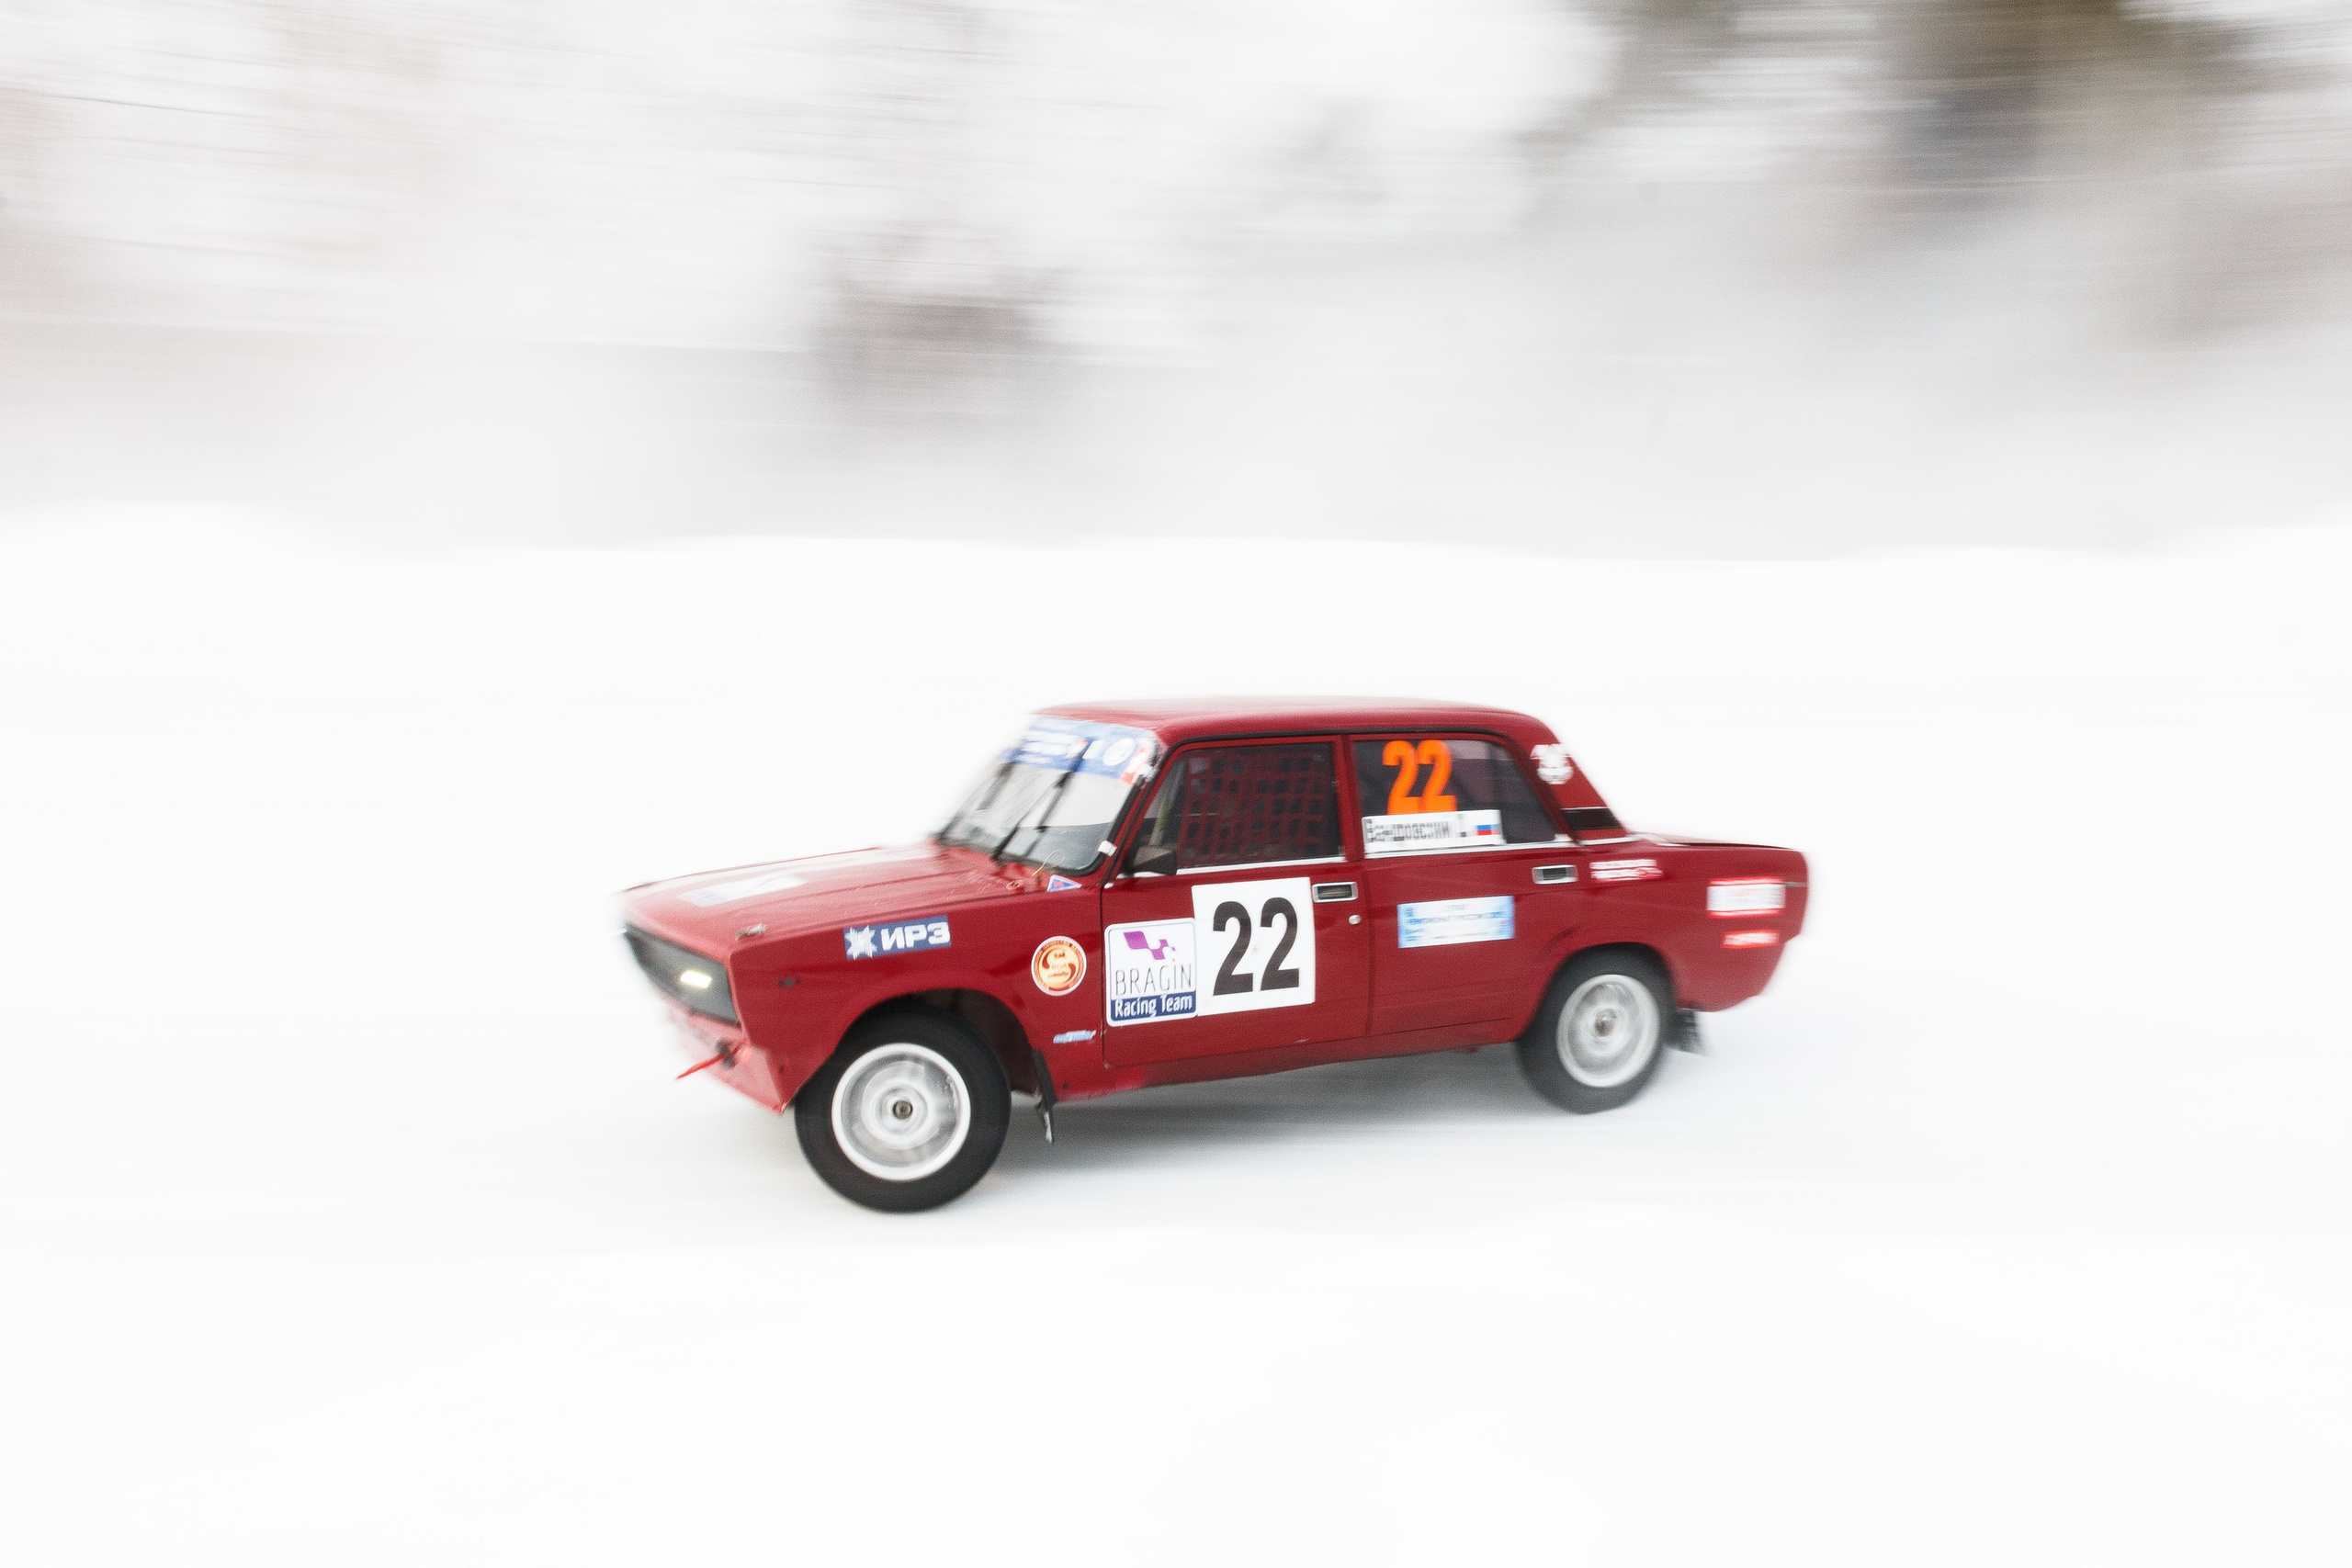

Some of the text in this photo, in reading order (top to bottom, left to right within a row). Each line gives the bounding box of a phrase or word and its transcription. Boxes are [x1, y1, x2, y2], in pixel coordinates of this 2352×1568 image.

[1382, 739, 1458, 815] 22
[880, 921, 951, 952] ИРЗ
[1213, 897, 1300, 997] 22
[1114, 964, 1193, 997] BRAGIN
[1114, 994, 1193, 1019] Racing Team
